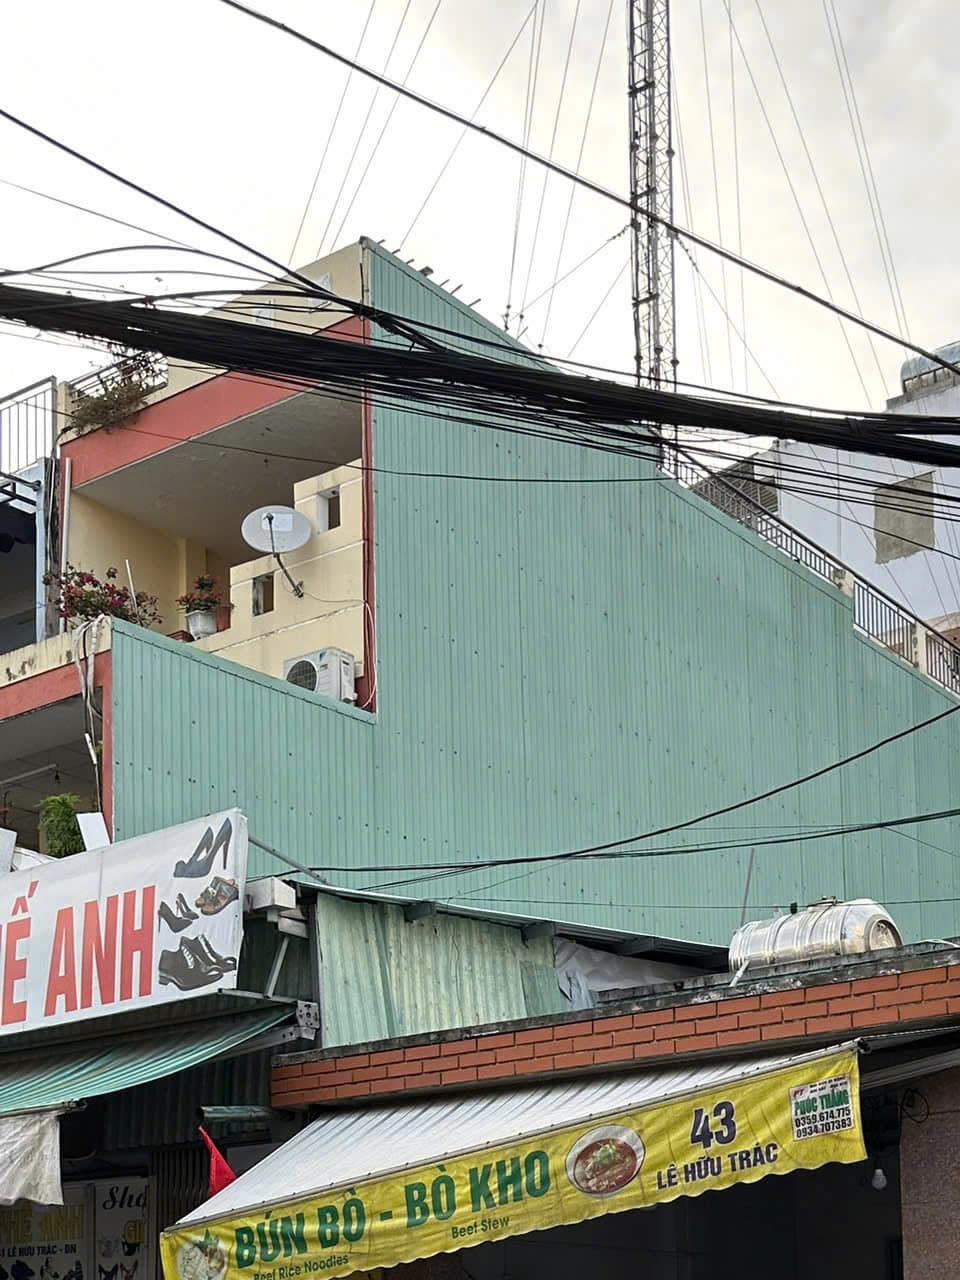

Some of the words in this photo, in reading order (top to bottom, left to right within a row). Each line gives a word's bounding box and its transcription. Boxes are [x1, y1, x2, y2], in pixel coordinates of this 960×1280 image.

[0, 880, 39, 1026] Ế
[44, 885, 156, 1017] ANH
[794, 1095, 818, 1116] PHÚC
[795, 1107, 851, 1128] 0359.674.775
[690, 1101, 737, 1149] 43
[656, 1164, 678, 1190] LÊ
[683, 1154, 722, 1184] HỮU
[727, 1142, 778, 1172] TRÁC
[234, 1211, 308, 1269] BÚN
[317, 1188, 367, 1250] BÒ
[404, 1165, 457, 1228] BÒ
[469, 1150, 550, 1212] KHO
[452, 1222, 478, 1239] Beef
[480, 1216, 510, 1233] Stew
[279, 1265, 301, 1280] Rice
[304, 1254, 349, 1274] Noodles
